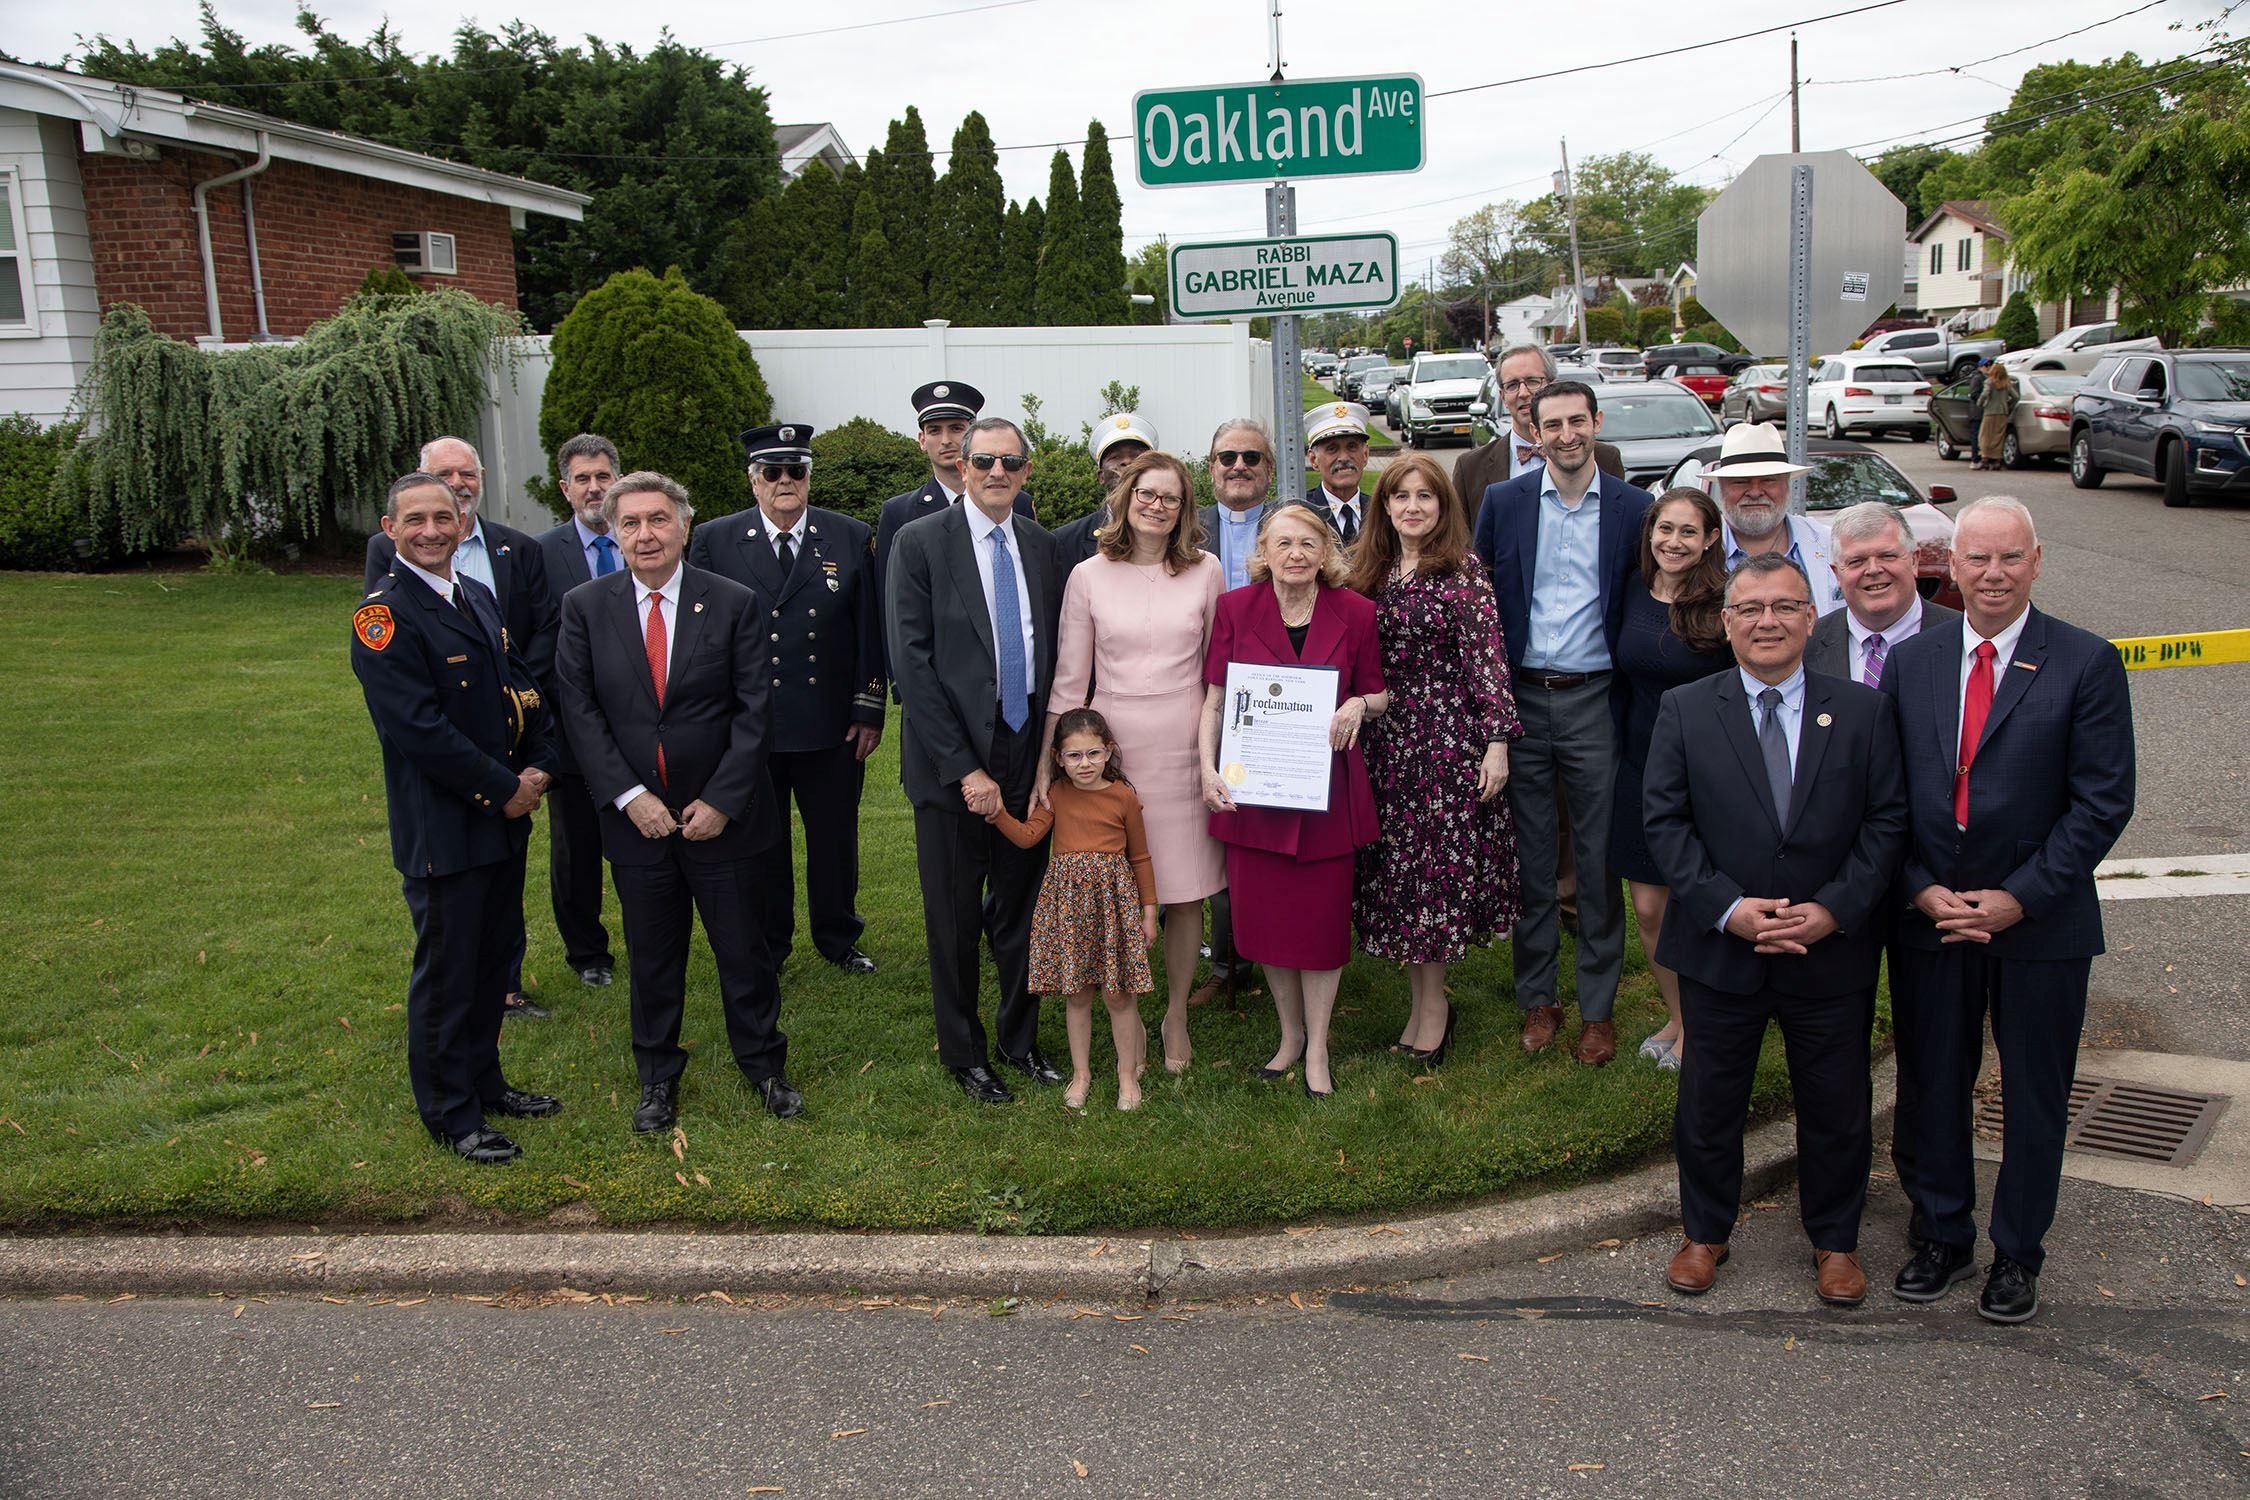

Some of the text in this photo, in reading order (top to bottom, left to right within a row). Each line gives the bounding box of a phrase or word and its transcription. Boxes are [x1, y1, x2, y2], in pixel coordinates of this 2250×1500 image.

[1145, 86, 1414, 168] Oakland Ave
[1256, 246, 1311, 265] RABBI
[1185, 262, 1384, 294] GABRIEL MAZA
[1256, 288, 1316, 306] Avenue
[1231, 690, 1313, 731] Proclamation
